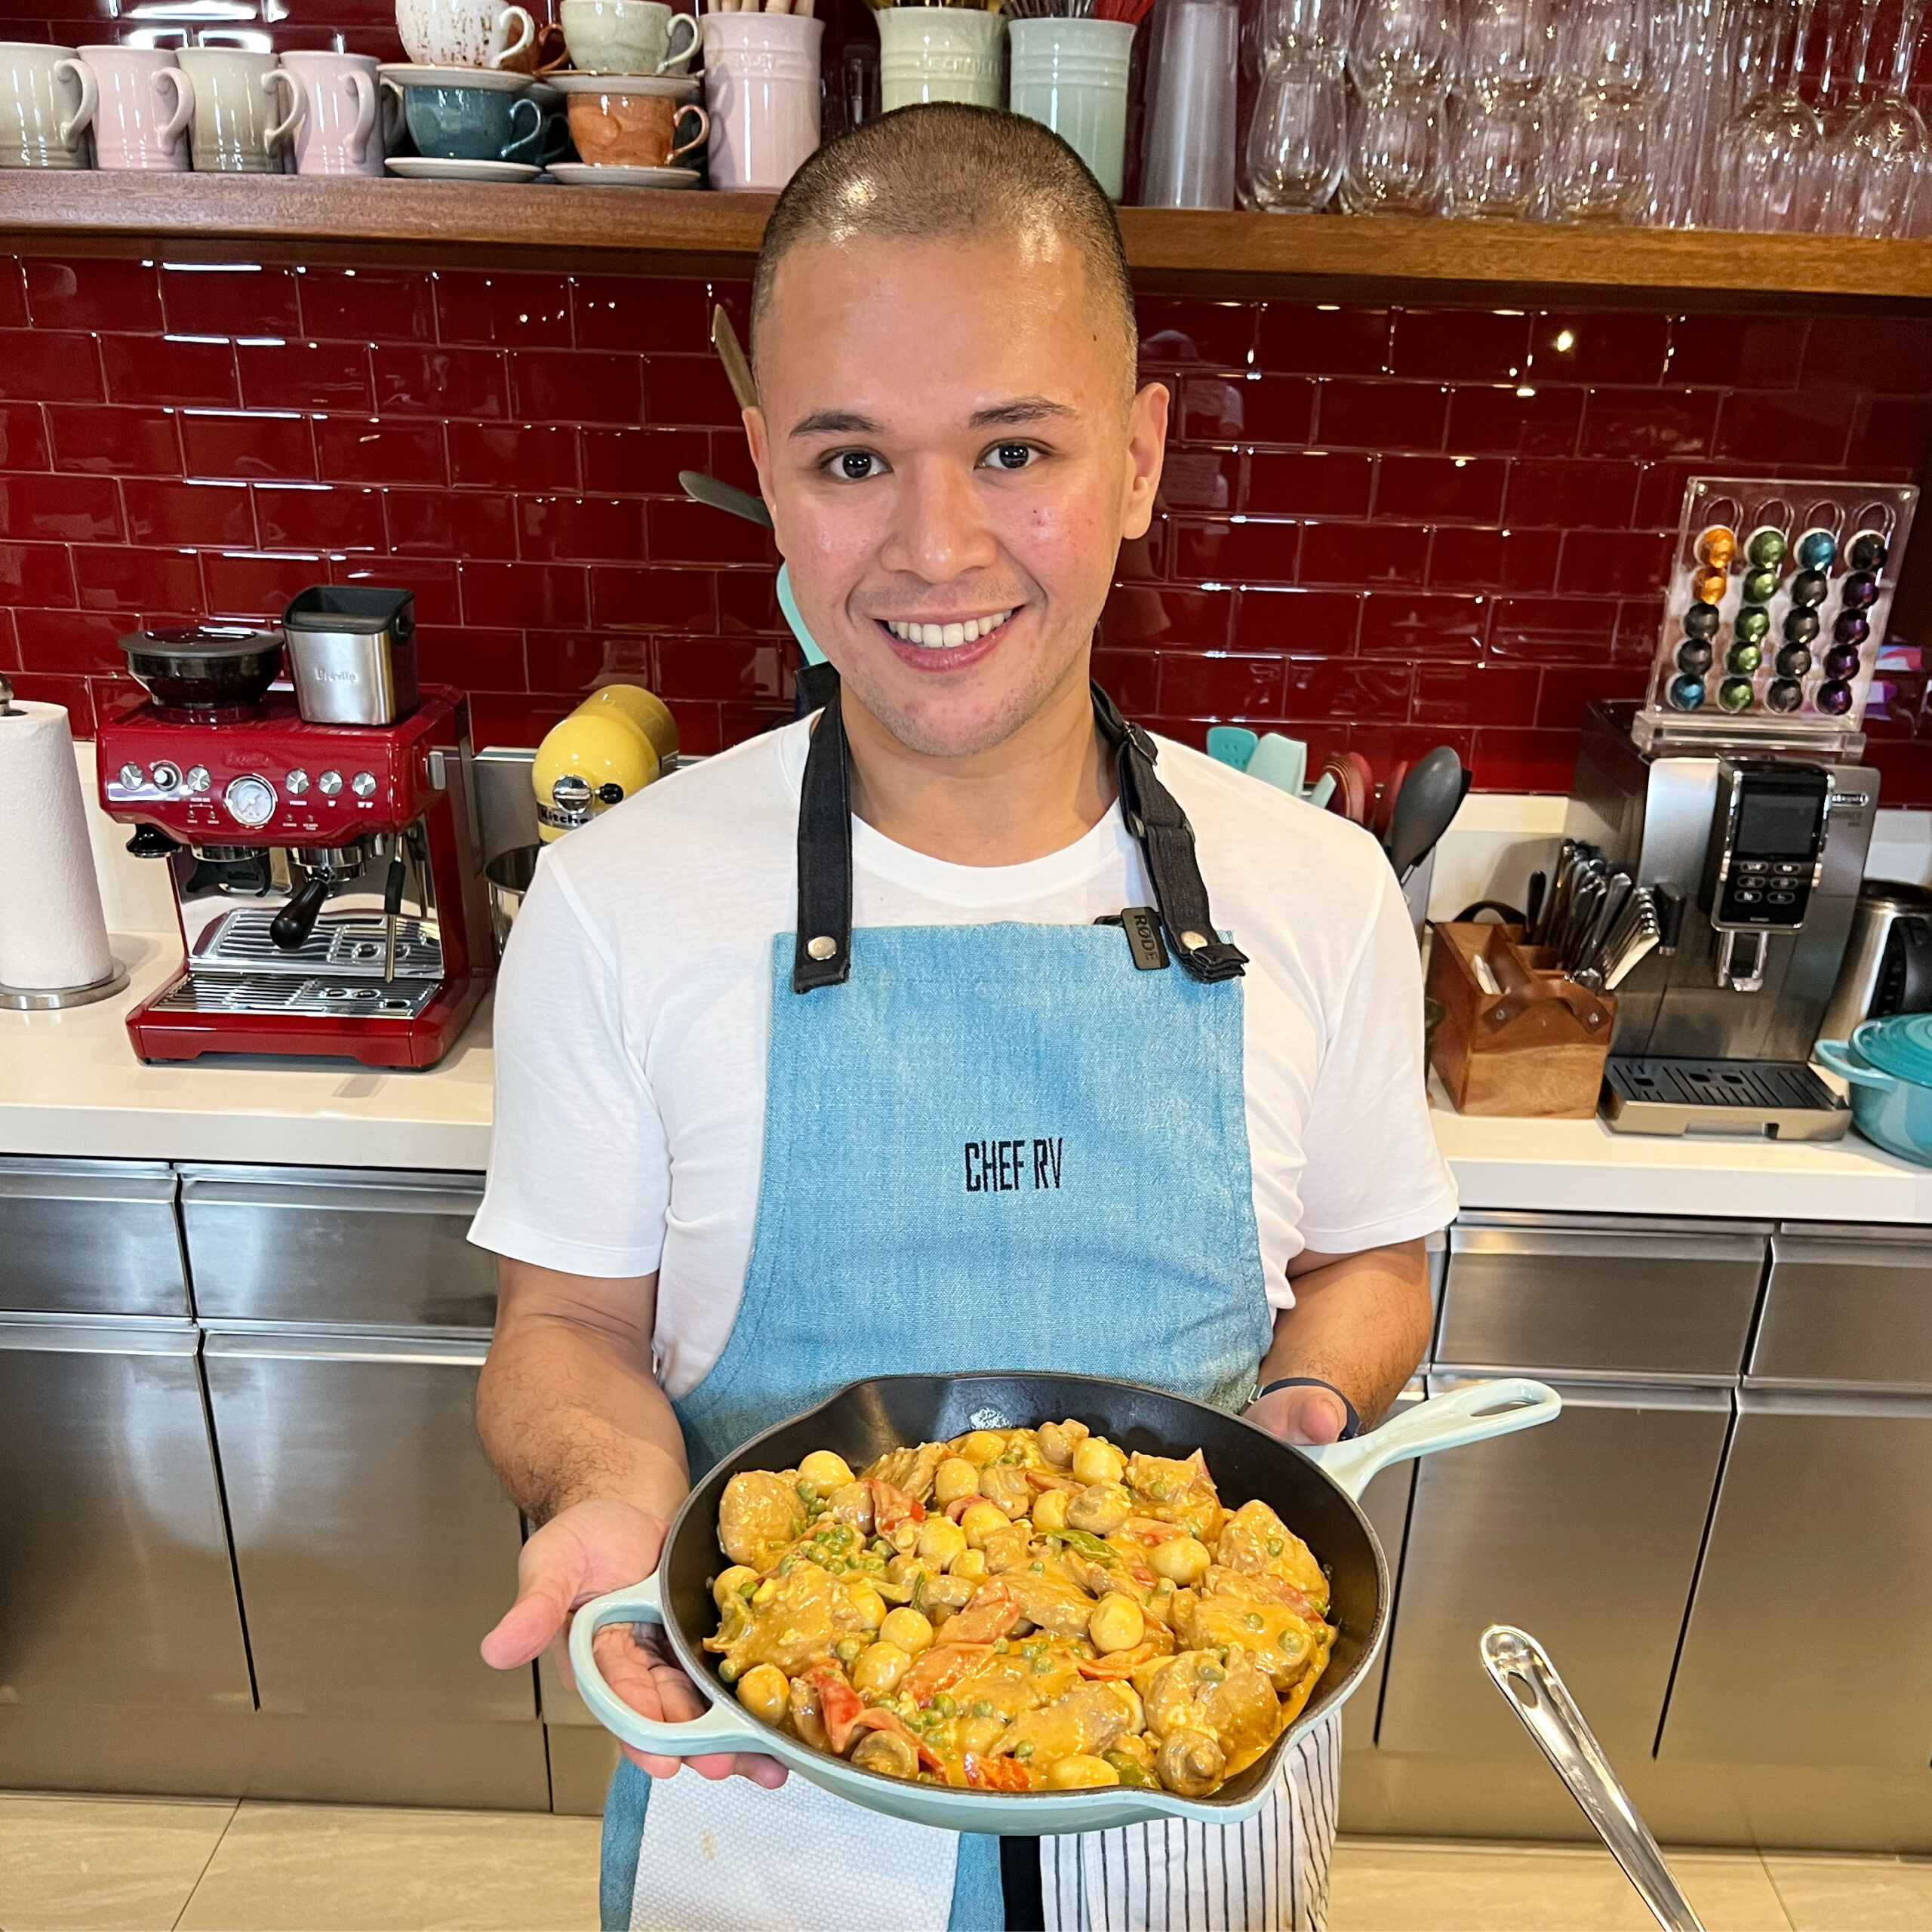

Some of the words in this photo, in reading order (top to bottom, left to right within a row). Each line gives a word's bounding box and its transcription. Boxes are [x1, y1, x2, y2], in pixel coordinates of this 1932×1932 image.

[1134, 915, 1159, 961] RØDE
[964, 1140, 1025, 1192] CHEF
[1033, 1137, 1063, 1189] RV
